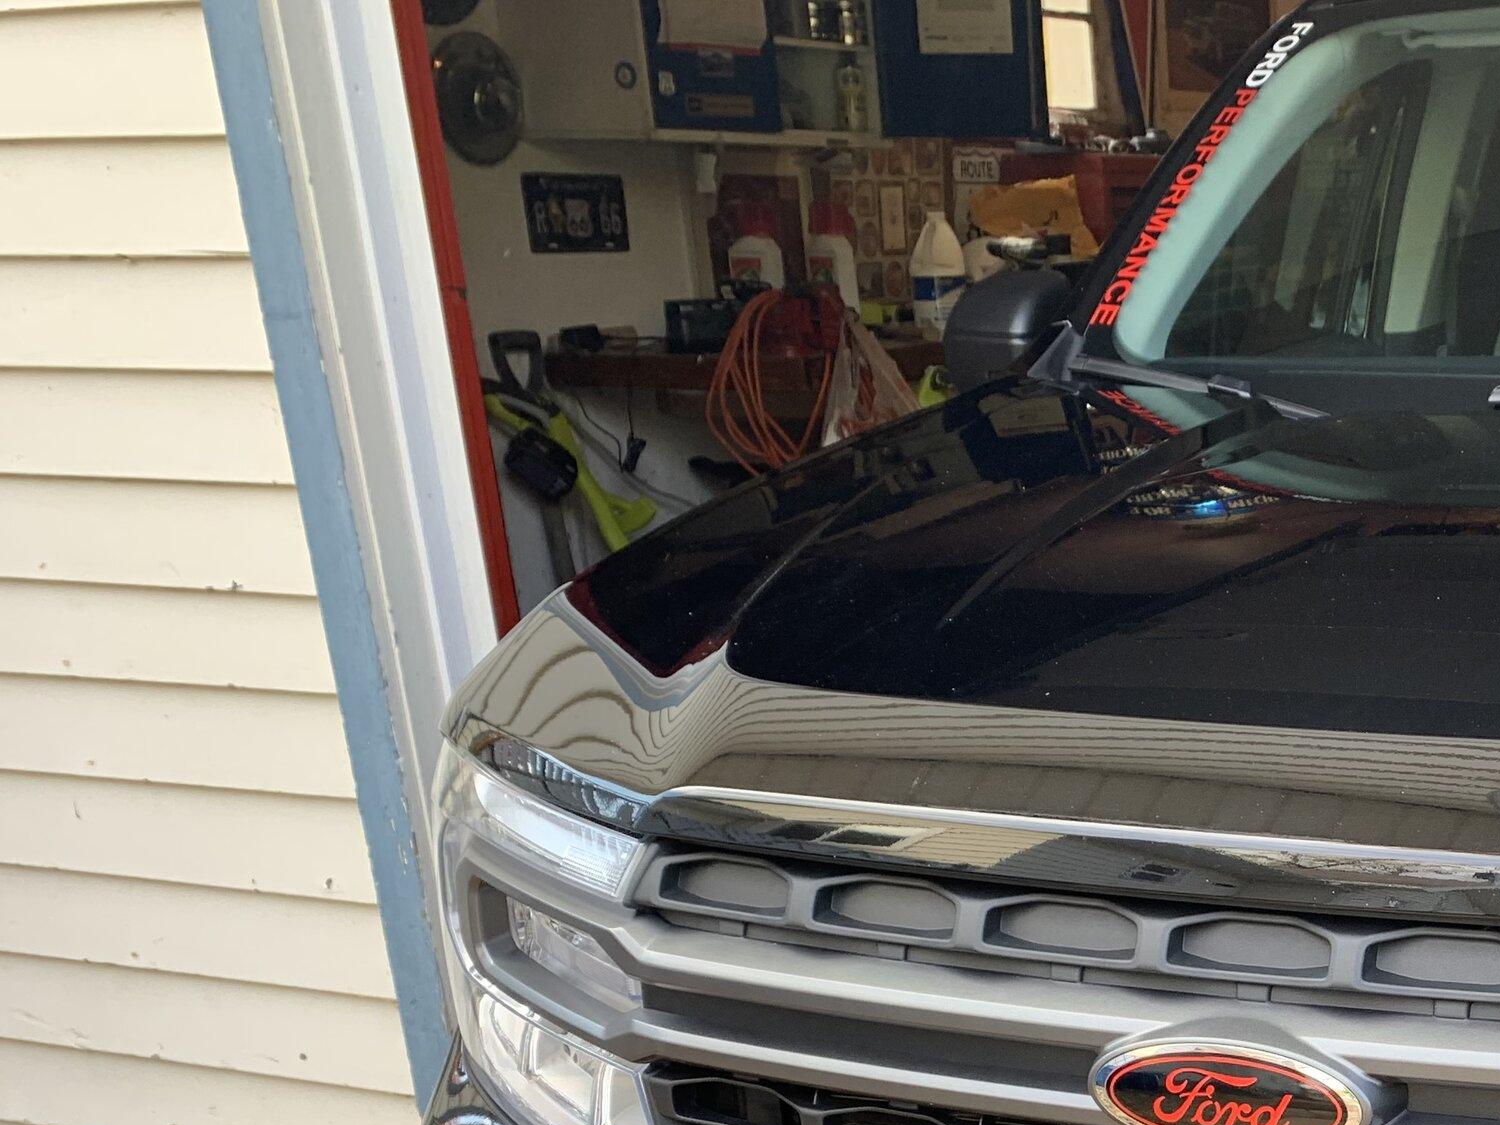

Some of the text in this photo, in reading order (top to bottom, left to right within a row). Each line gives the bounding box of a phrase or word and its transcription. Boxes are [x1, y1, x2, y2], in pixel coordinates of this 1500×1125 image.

[1245, 21, 1314, 88] FORD
[960, 159, 994, 179] ROUTE
[1089, 87, 1260, 326] PERFORMANCE
